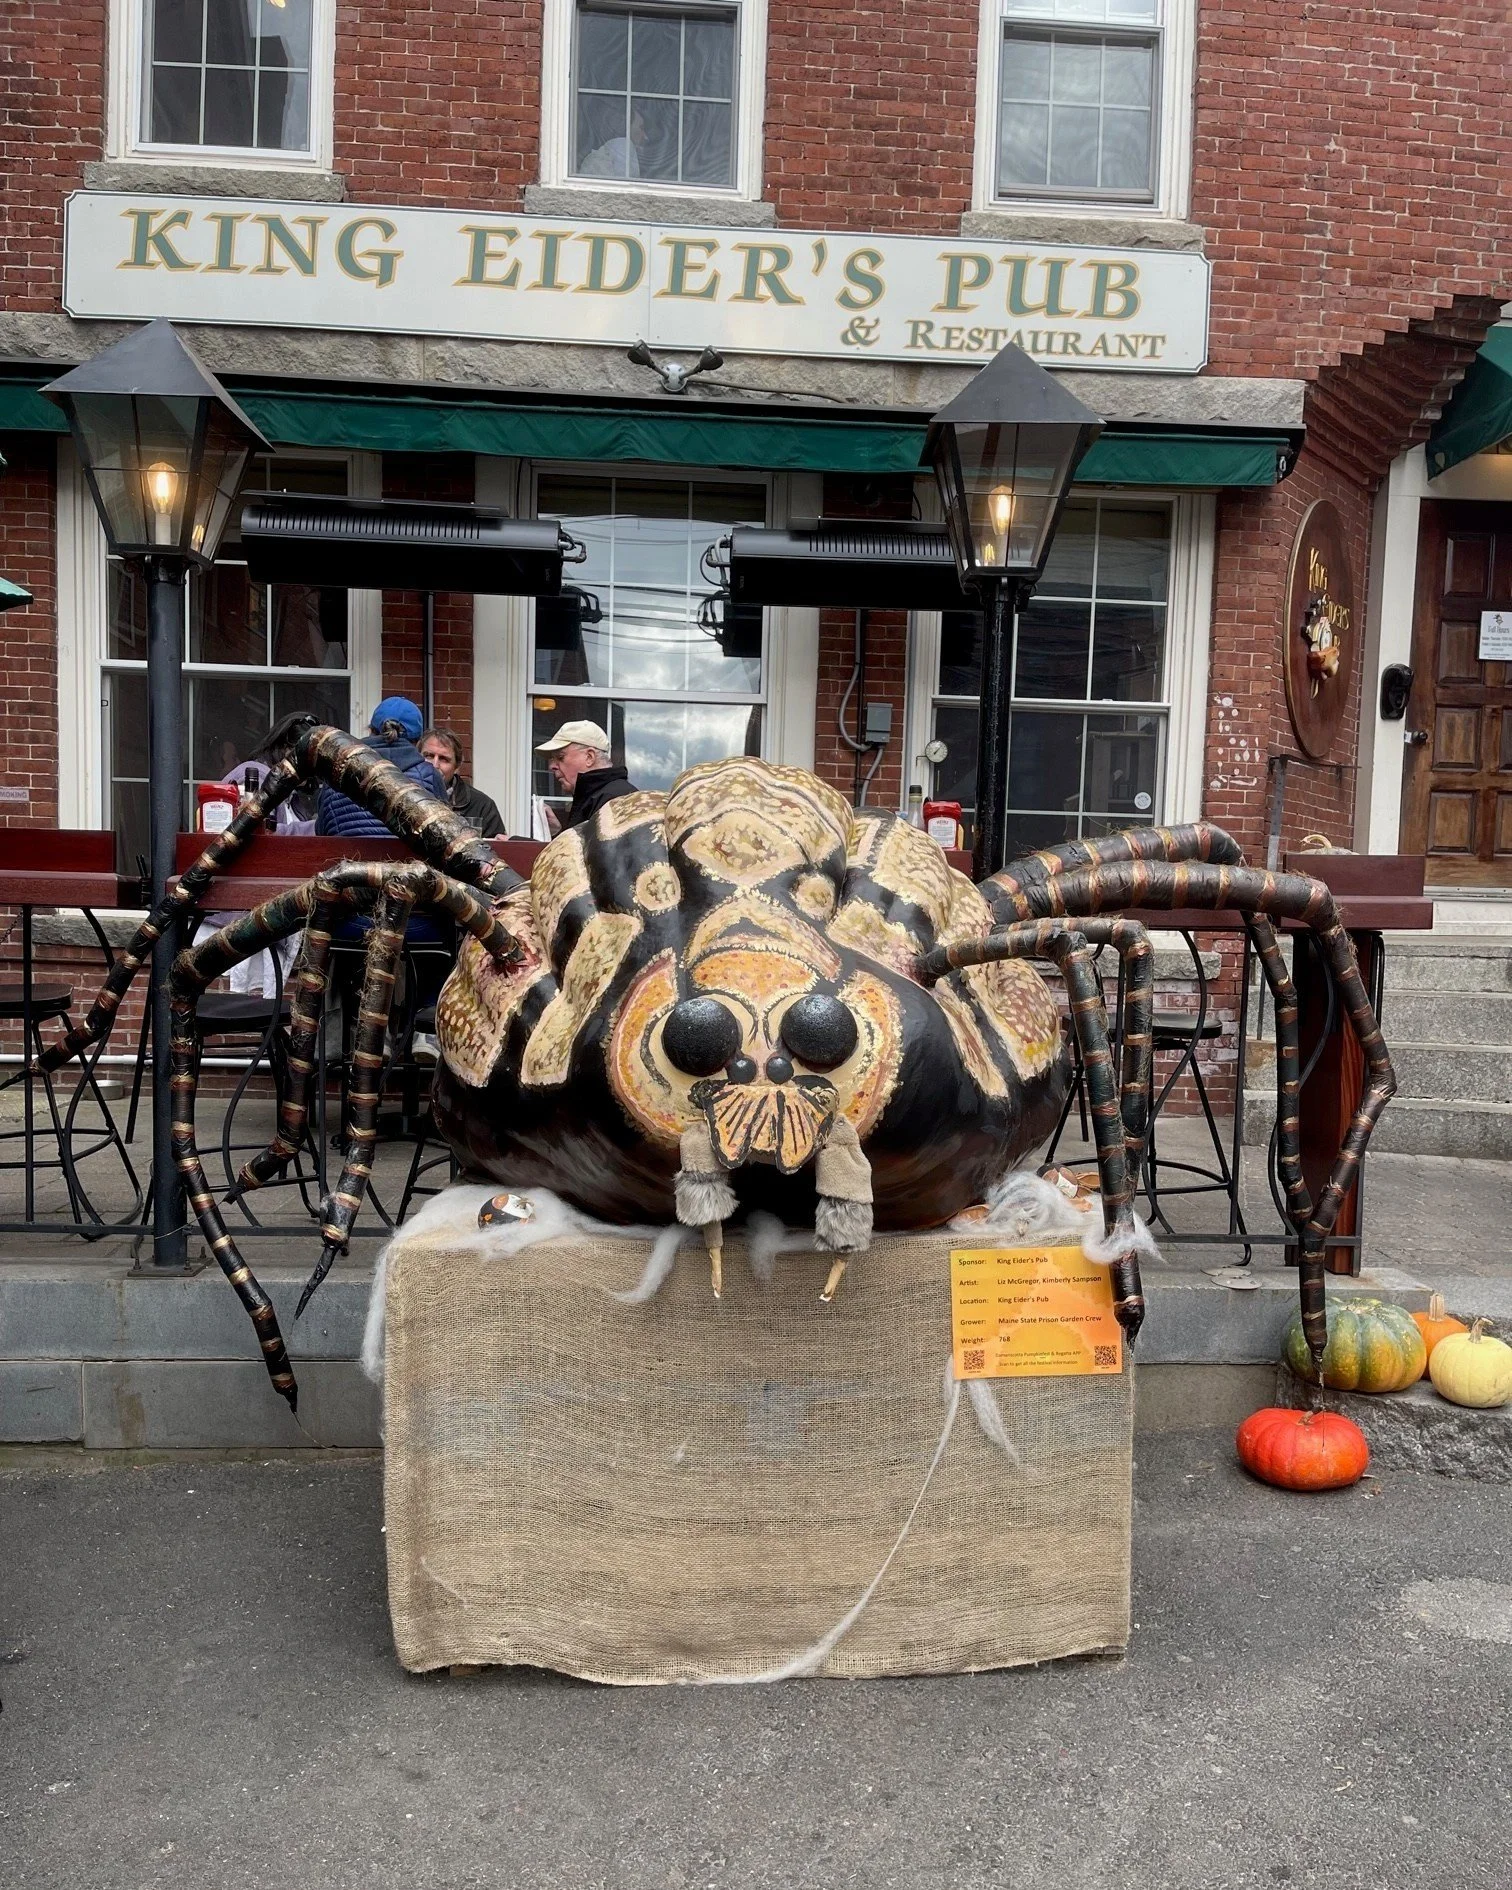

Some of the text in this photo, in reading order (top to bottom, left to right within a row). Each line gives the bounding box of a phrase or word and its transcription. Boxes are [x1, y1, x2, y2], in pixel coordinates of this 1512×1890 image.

[117, 208, 1142, 322] KING EIDER'S PUB
[839, 315, 1167, 360] & RESTAURANT
[958, 1258, 987, 1266] Sponsor:
[1072, 1275, 1102, 1283] Sampson
